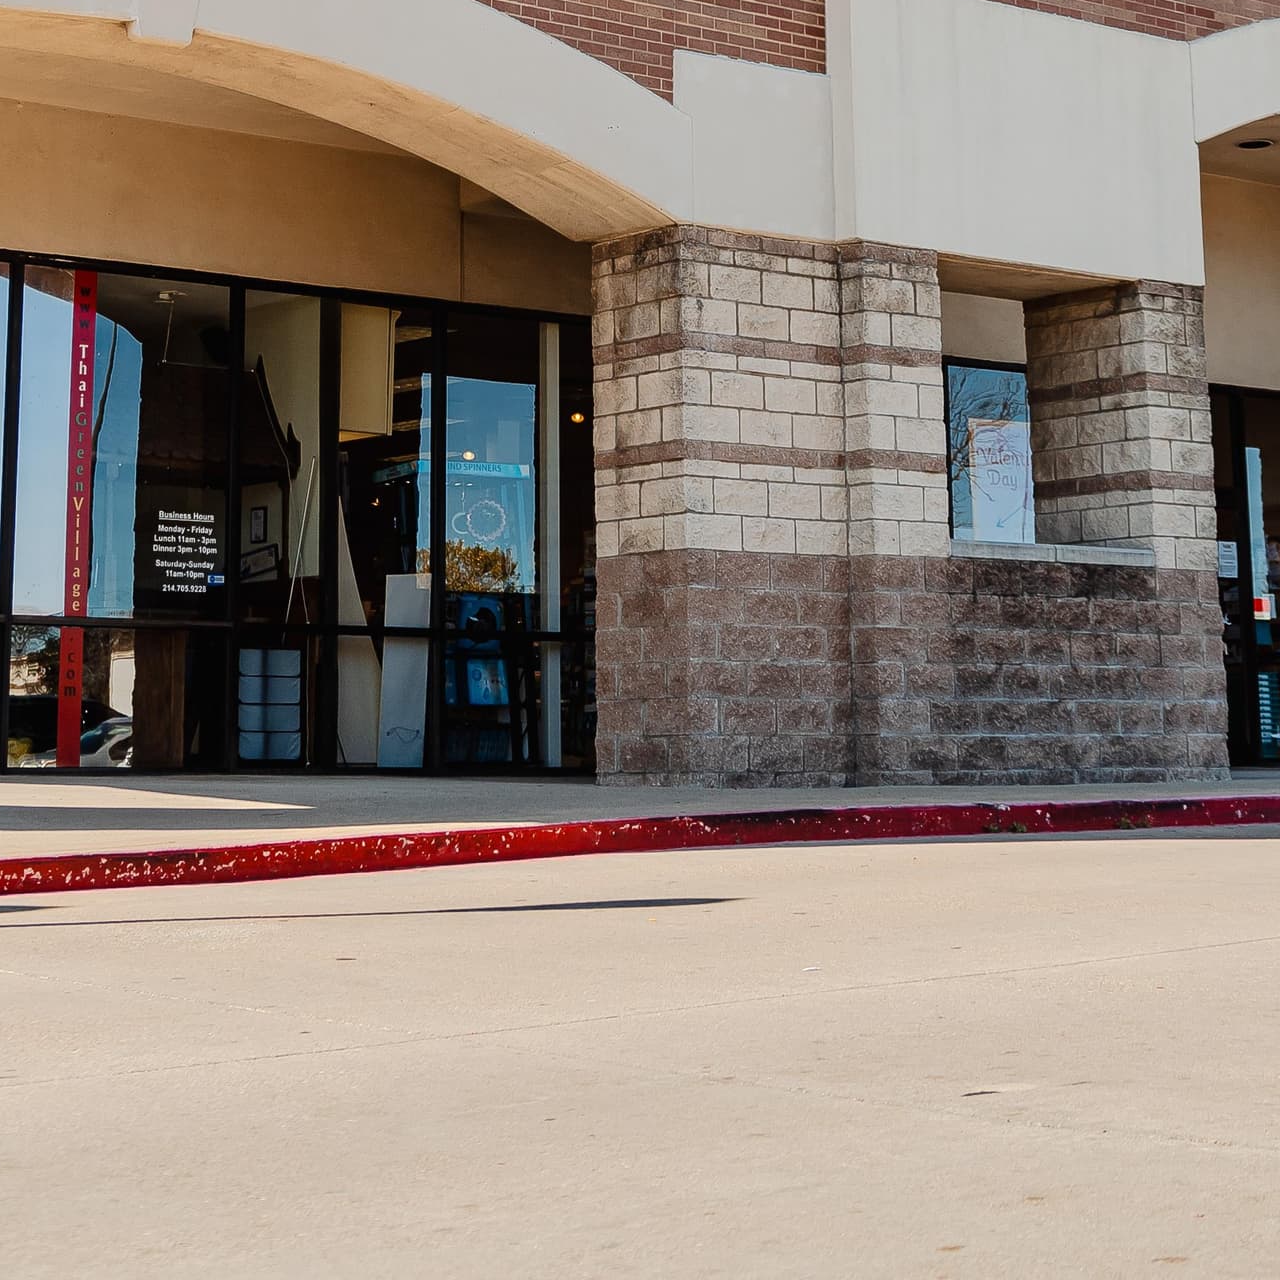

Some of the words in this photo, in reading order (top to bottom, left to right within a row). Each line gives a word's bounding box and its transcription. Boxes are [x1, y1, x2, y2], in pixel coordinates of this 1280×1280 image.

[463, 462, 502, 473] SPINNERS
[987, 469, 1018, 491] Day
[158, 510, 192, 521] Business
[193, 512, 215, 522] Hours
[157, 524, 186, 534] Monday
[191, 525, 213, 536] Friday
[153, 534, 176, 542] Lunch
[178, 535, 196, 543] 11am
[201, 536, 217, 546] 3pm
[152, 544, 177, 552] Dinner
[177, 545, 193, 555] 3pm
[198, 546, 218, 555] 10pm
[155, 558, 215, 571] Saturday-Sunday
[162, 584, 207, 593] 214.705.9228
